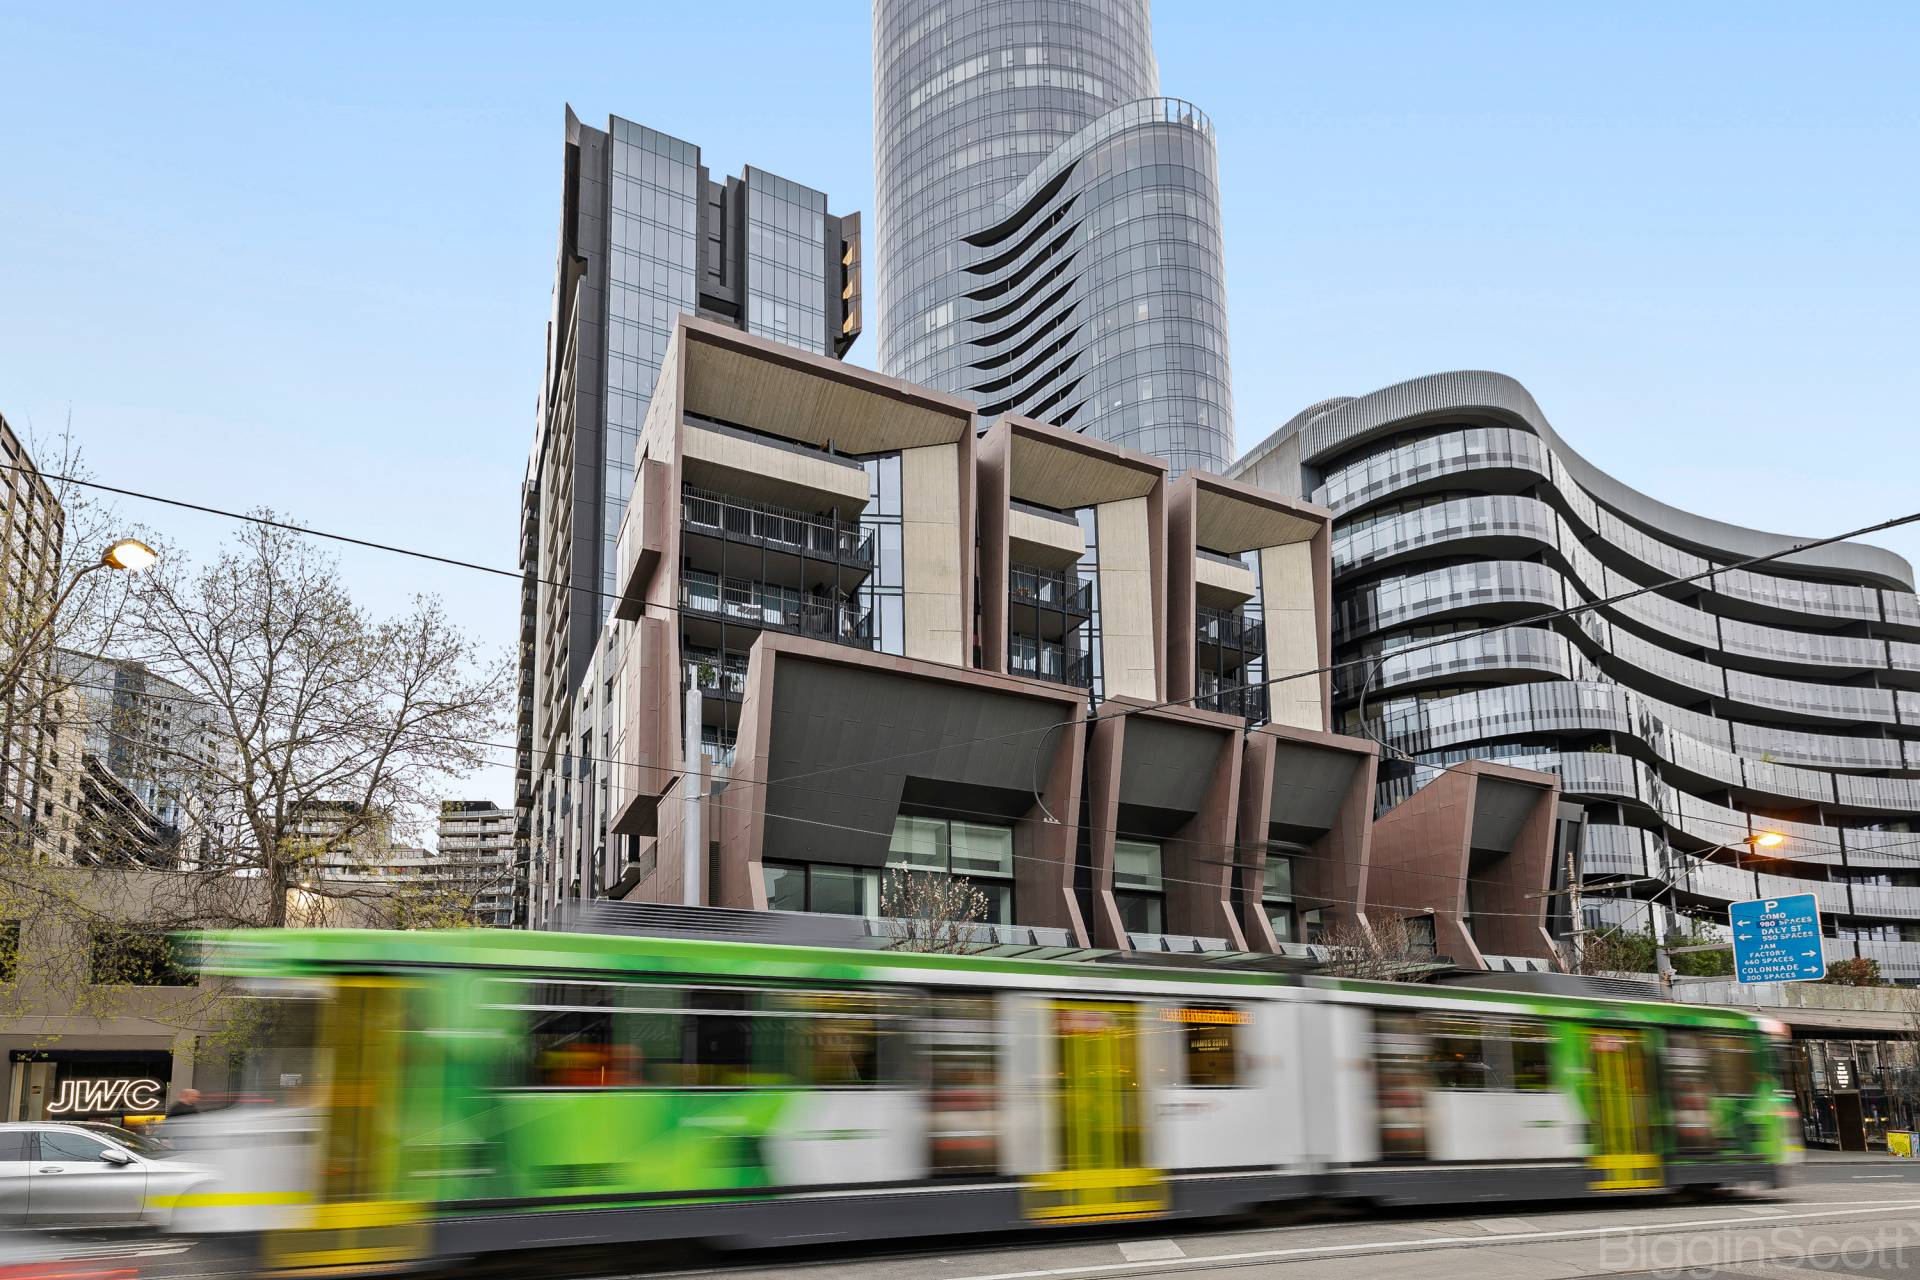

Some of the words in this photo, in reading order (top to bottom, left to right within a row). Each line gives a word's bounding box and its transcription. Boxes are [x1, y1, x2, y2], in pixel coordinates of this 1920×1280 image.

[1764, 900, 1778, 913] P
[1760, 912, 1786, 921] COMO
[1759, 920, 1776, 928] 980
[1779, 916, 1812, 926] SPACES
[1761, 926, 1787, 935] DALY
[1762, 934, 1778, 942] 550
[1780, 931, 1814, 940] SPACES
[1750, 949, 1786, 958] FACTORY
[1762, 956, 1794, 964] SPACES
[1742, 964, 1799, 974] COLONNADE
[47, 1079, 161, 1113] JWC
